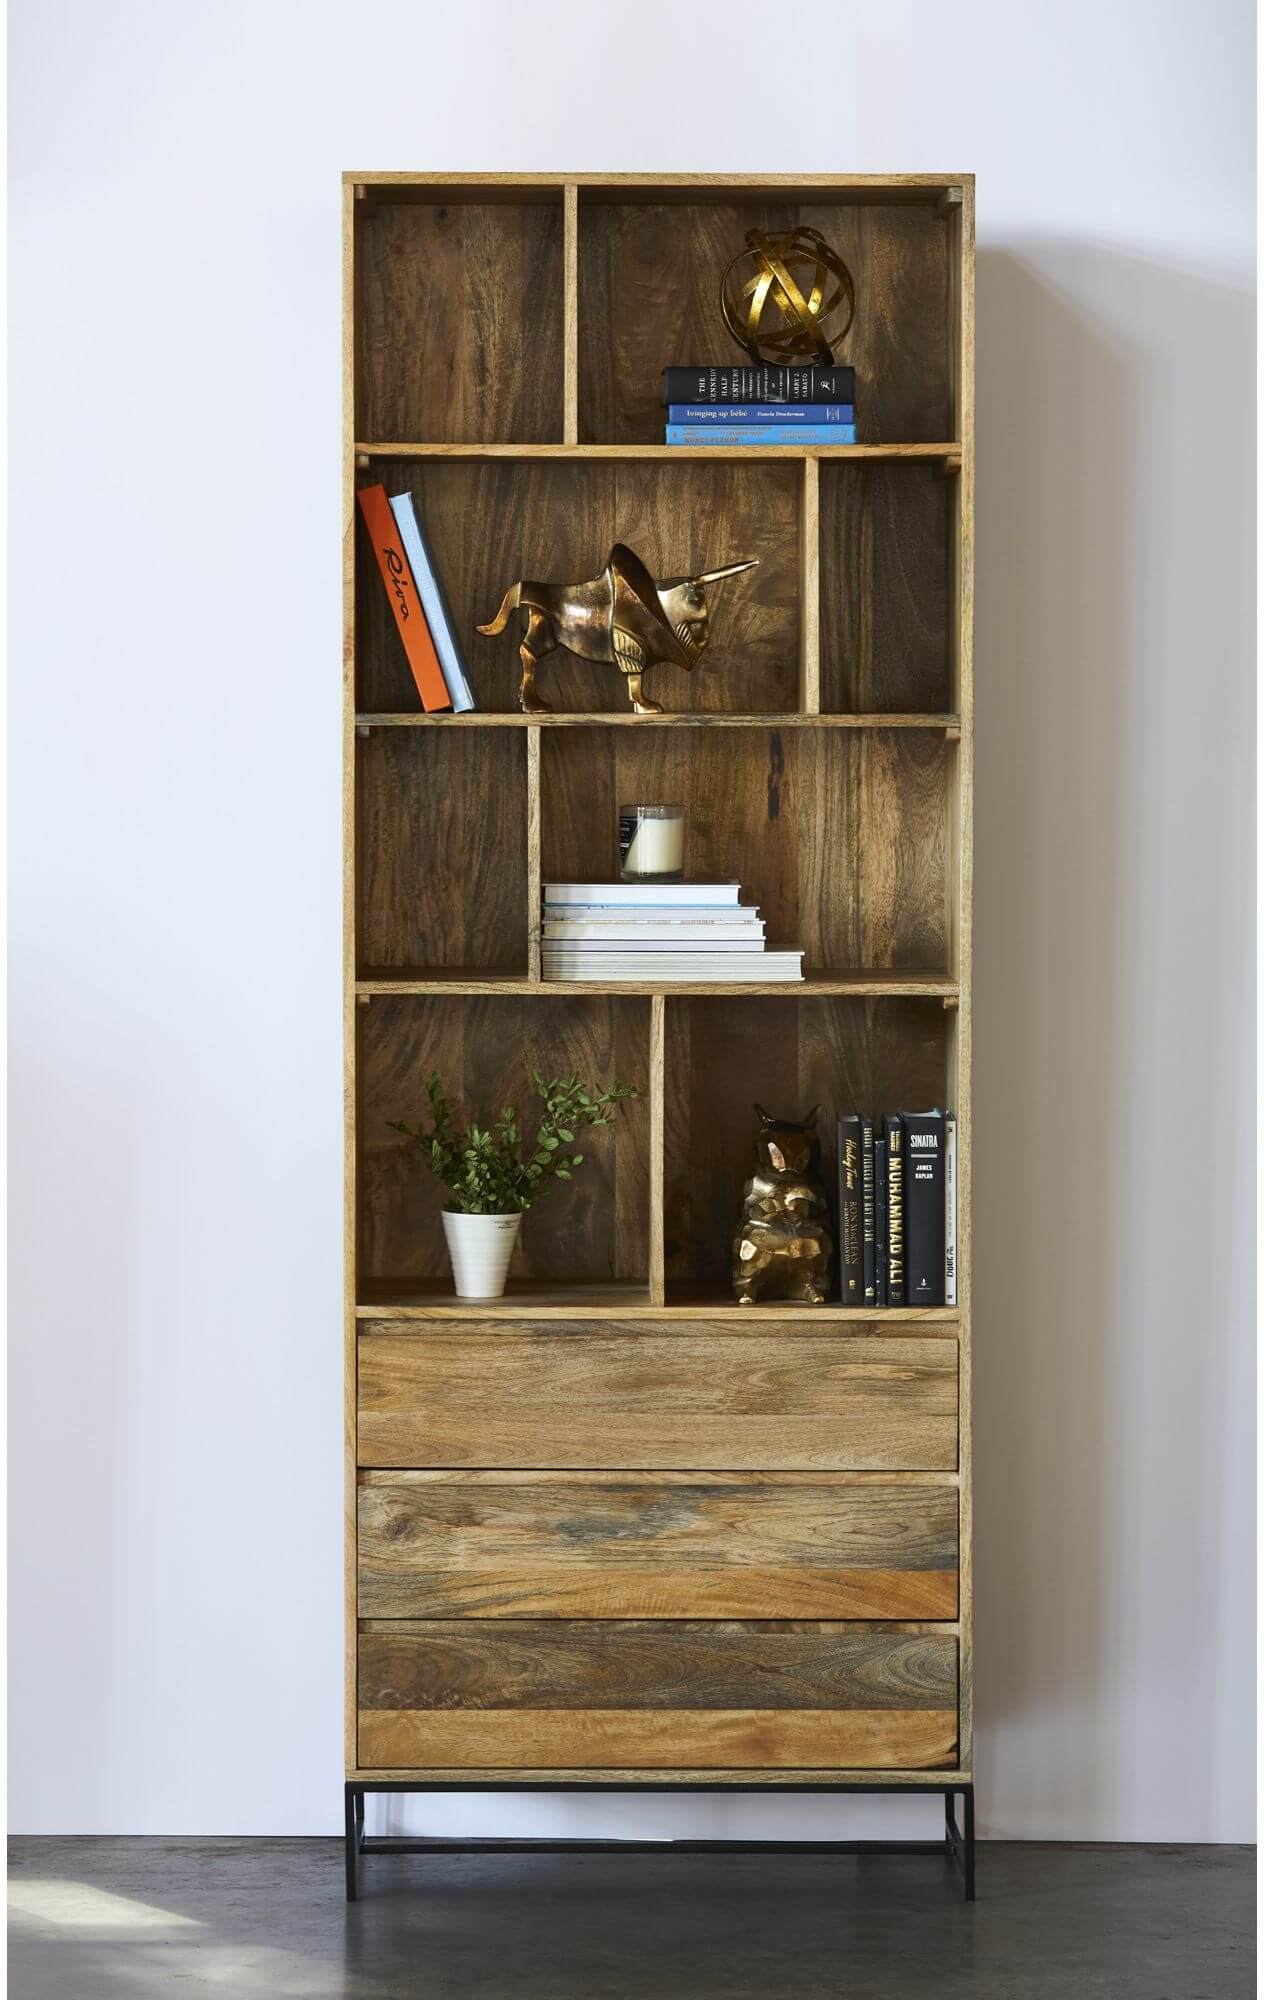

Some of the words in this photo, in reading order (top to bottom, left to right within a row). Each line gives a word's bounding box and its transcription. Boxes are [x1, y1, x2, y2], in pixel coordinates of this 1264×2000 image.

[686, 409, 718, 418] bringing
[730, 409, 748, 417] bébé
[383, 547, 409, 623] Riva
[910, 1134, 938, 1148] SINATRA
[849, 1201, 858, 1222] RON
[888, 1157, 903, 1255] MUHAMMAD
[889, 1260, 903, 1285] ALI
